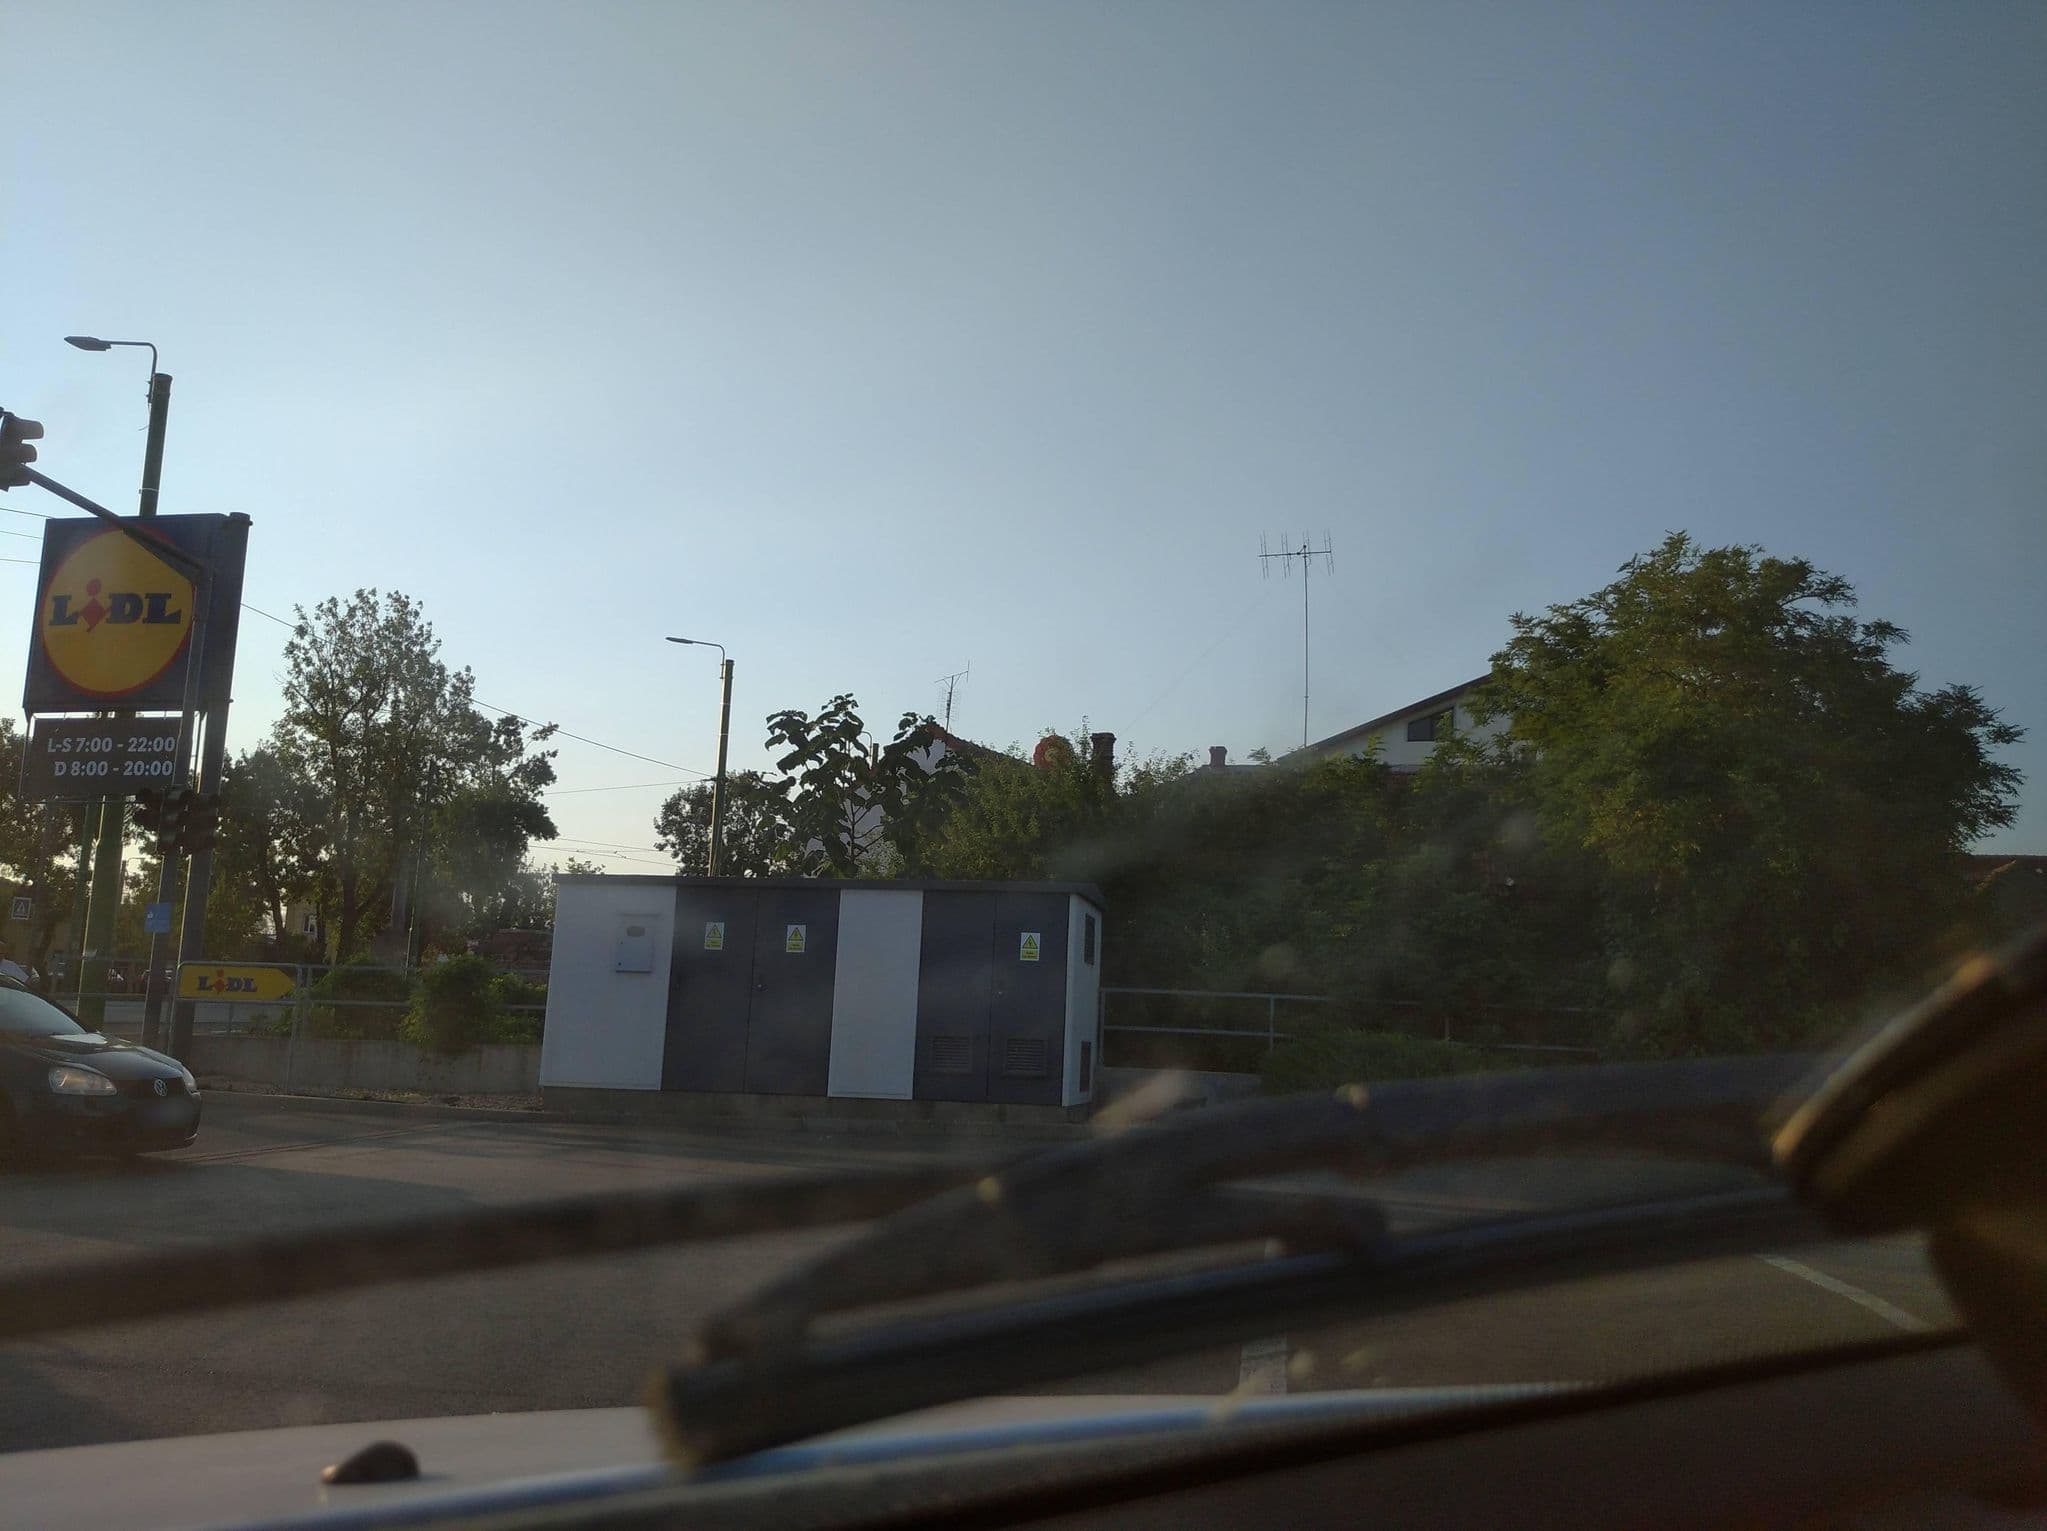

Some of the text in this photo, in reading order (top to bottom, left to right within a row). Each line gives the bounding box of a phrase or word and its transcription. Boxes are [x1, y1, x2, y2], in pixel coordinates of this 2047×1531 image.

[47, 737, 72, 752] L-S
[76, 737, 113, 752] 7:00
[128, 736, 176, 752] 22:00
[55, 761, 67, 776] D
[70, 760, 108, 776] 8:00
[123, 760, 173, 776] 20:00
